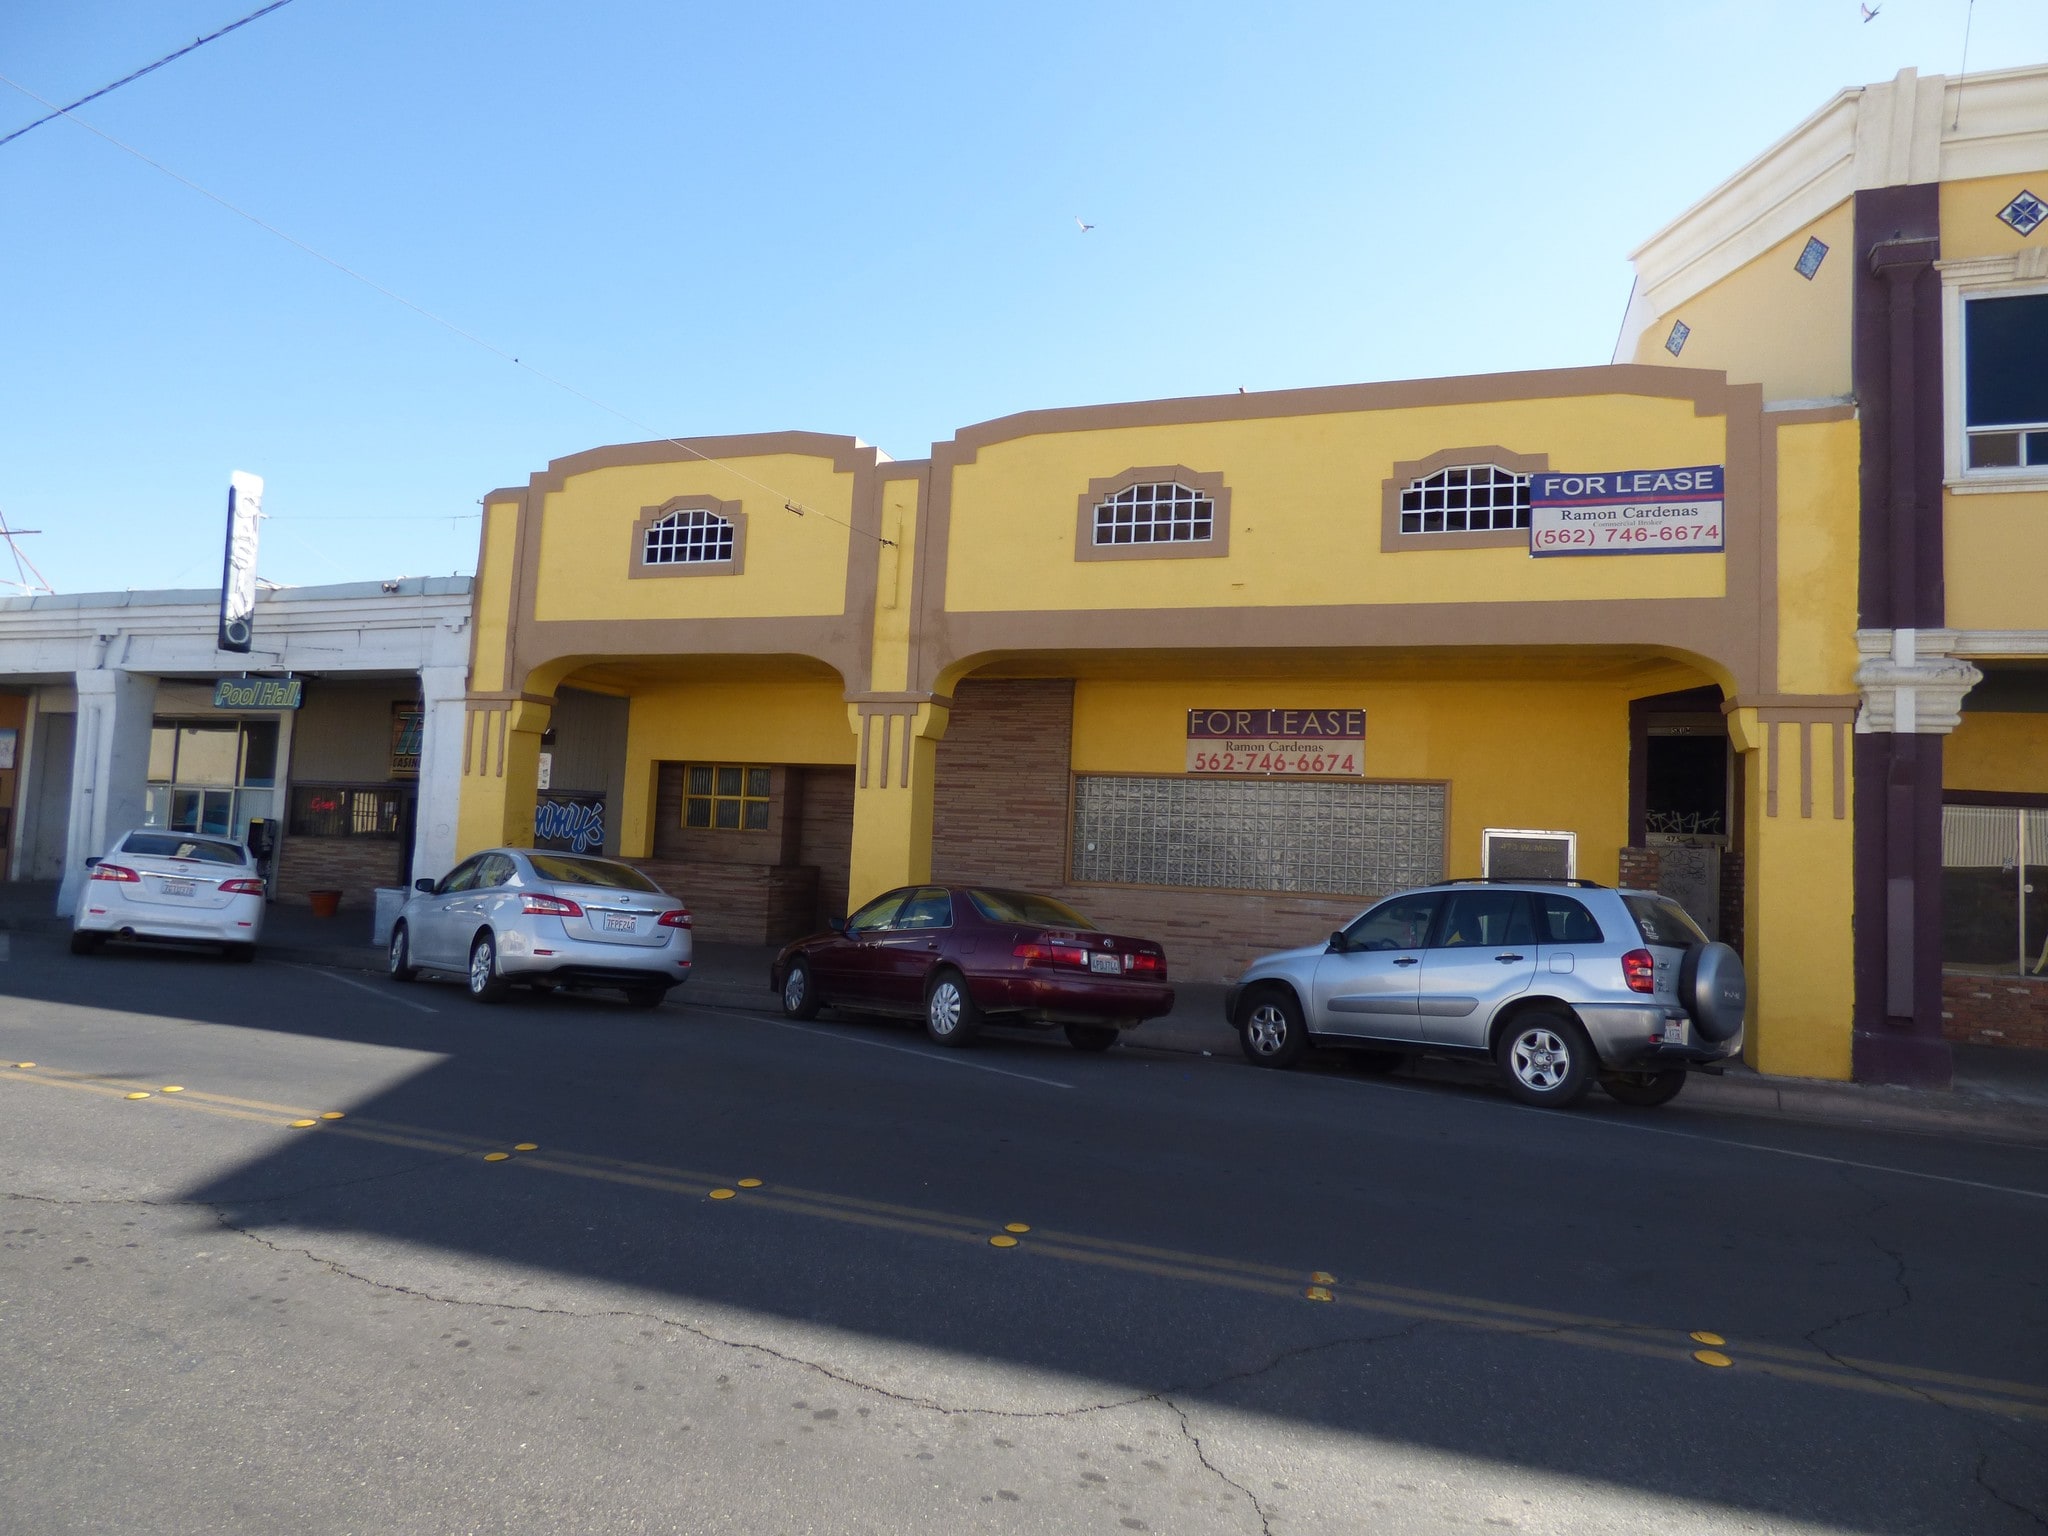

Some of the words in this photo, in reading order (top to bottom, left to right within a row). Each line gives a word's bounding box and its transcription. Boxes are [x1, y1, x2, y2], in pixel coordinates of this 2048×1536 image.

[1545, 477, 1606, 497] FOR
[1616, 471, 1714, 493] LEASE
[1561, 509, 1617, 521] Ramon
[1623, 506, 1699, 519] Cardenas
[1593, 520, 1636, 528] Commercial
[1638, 518, 1663, 526] Broker
[1535, 529, 1596, 548] (562)
[1605, 524, 1720, 543] 746-6674
[215, 681, 262, 706] Pool
[260, 681, 301, 706] Hall
[1191, 711, 1252, 735] FOR
[1267, 711, 1361, 735] LEASE
[1226, 741, 1265, 752] Ramon
[1268, 741, 1324, 753] Cardenas
[1195, 753, 1355, 772] 562-746-6674
[1535, 844, 1557, 853] Main
